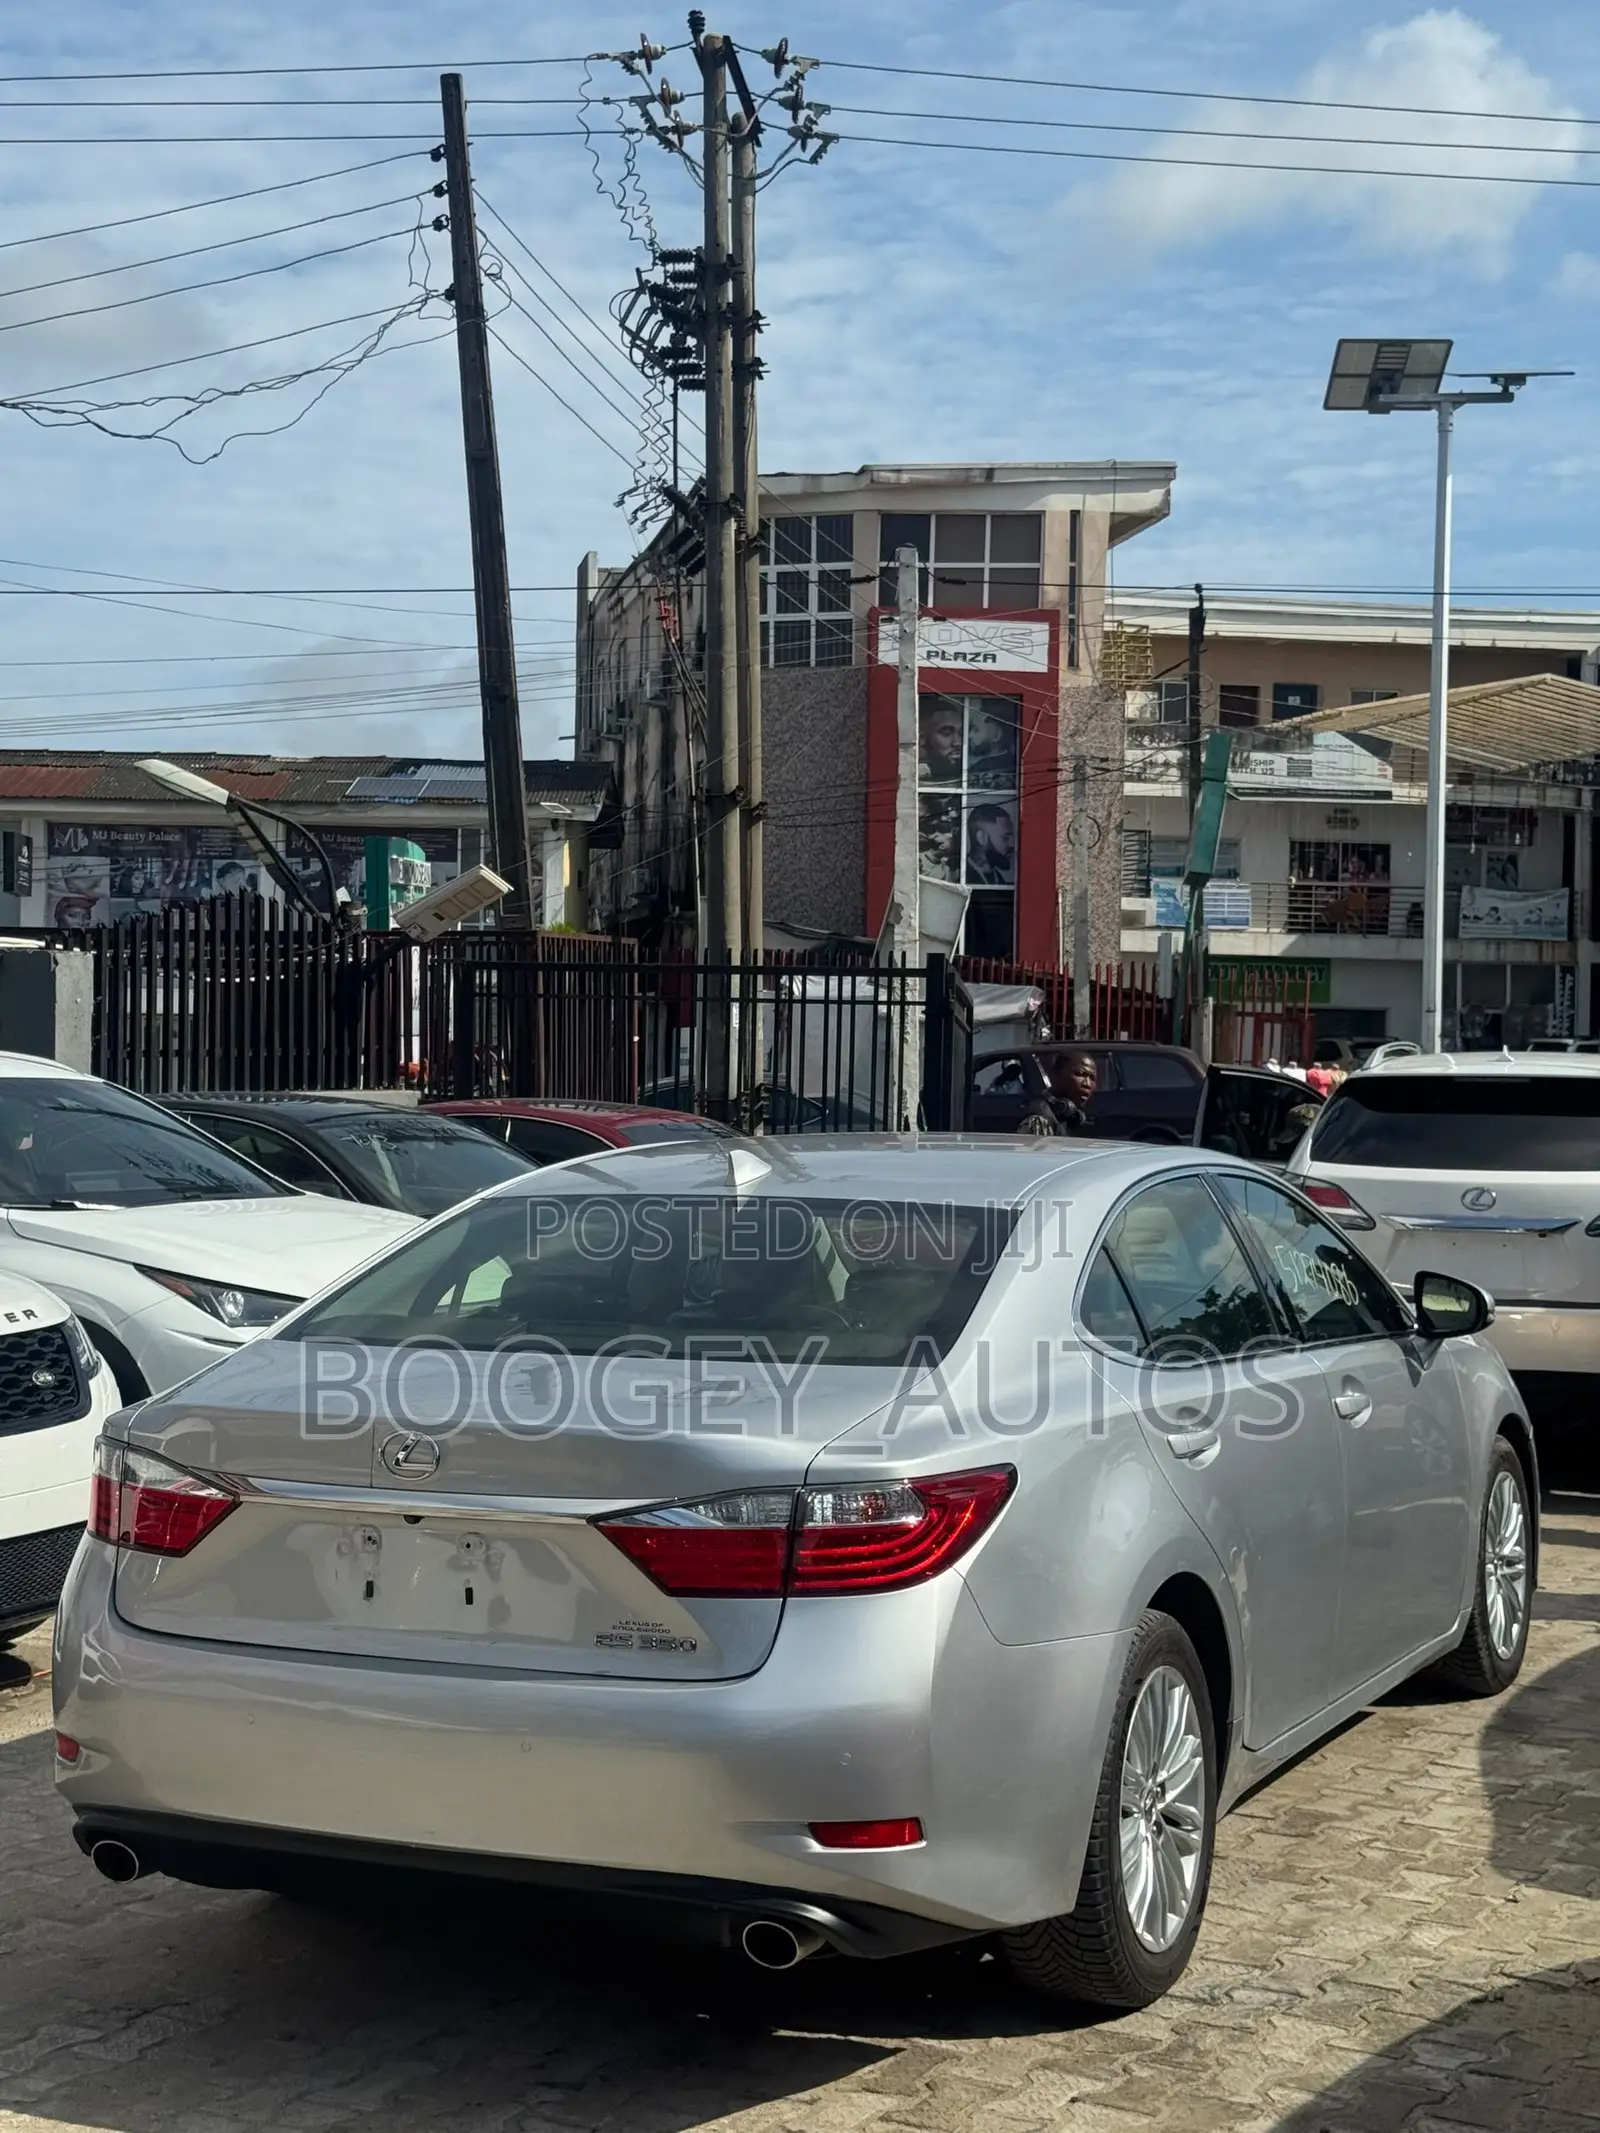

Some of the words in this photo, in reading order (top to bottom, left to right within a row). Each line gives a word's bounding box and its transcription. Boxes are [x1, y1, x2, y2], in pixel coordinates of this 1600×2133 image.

[926, 650, 997, 663] PLAZA
[92, 830, 107, 840] MJ
[110, 831, 146, 842] Beauty
[148, 831, 181, 842] Palace
[612, 1625, 671, 1634] ENGLEWOOD
[619, 1620, 650, 1628] LEXUS
[594, 1632, 634, 1649] ES
[637, 1635, 698, 1654] 350
